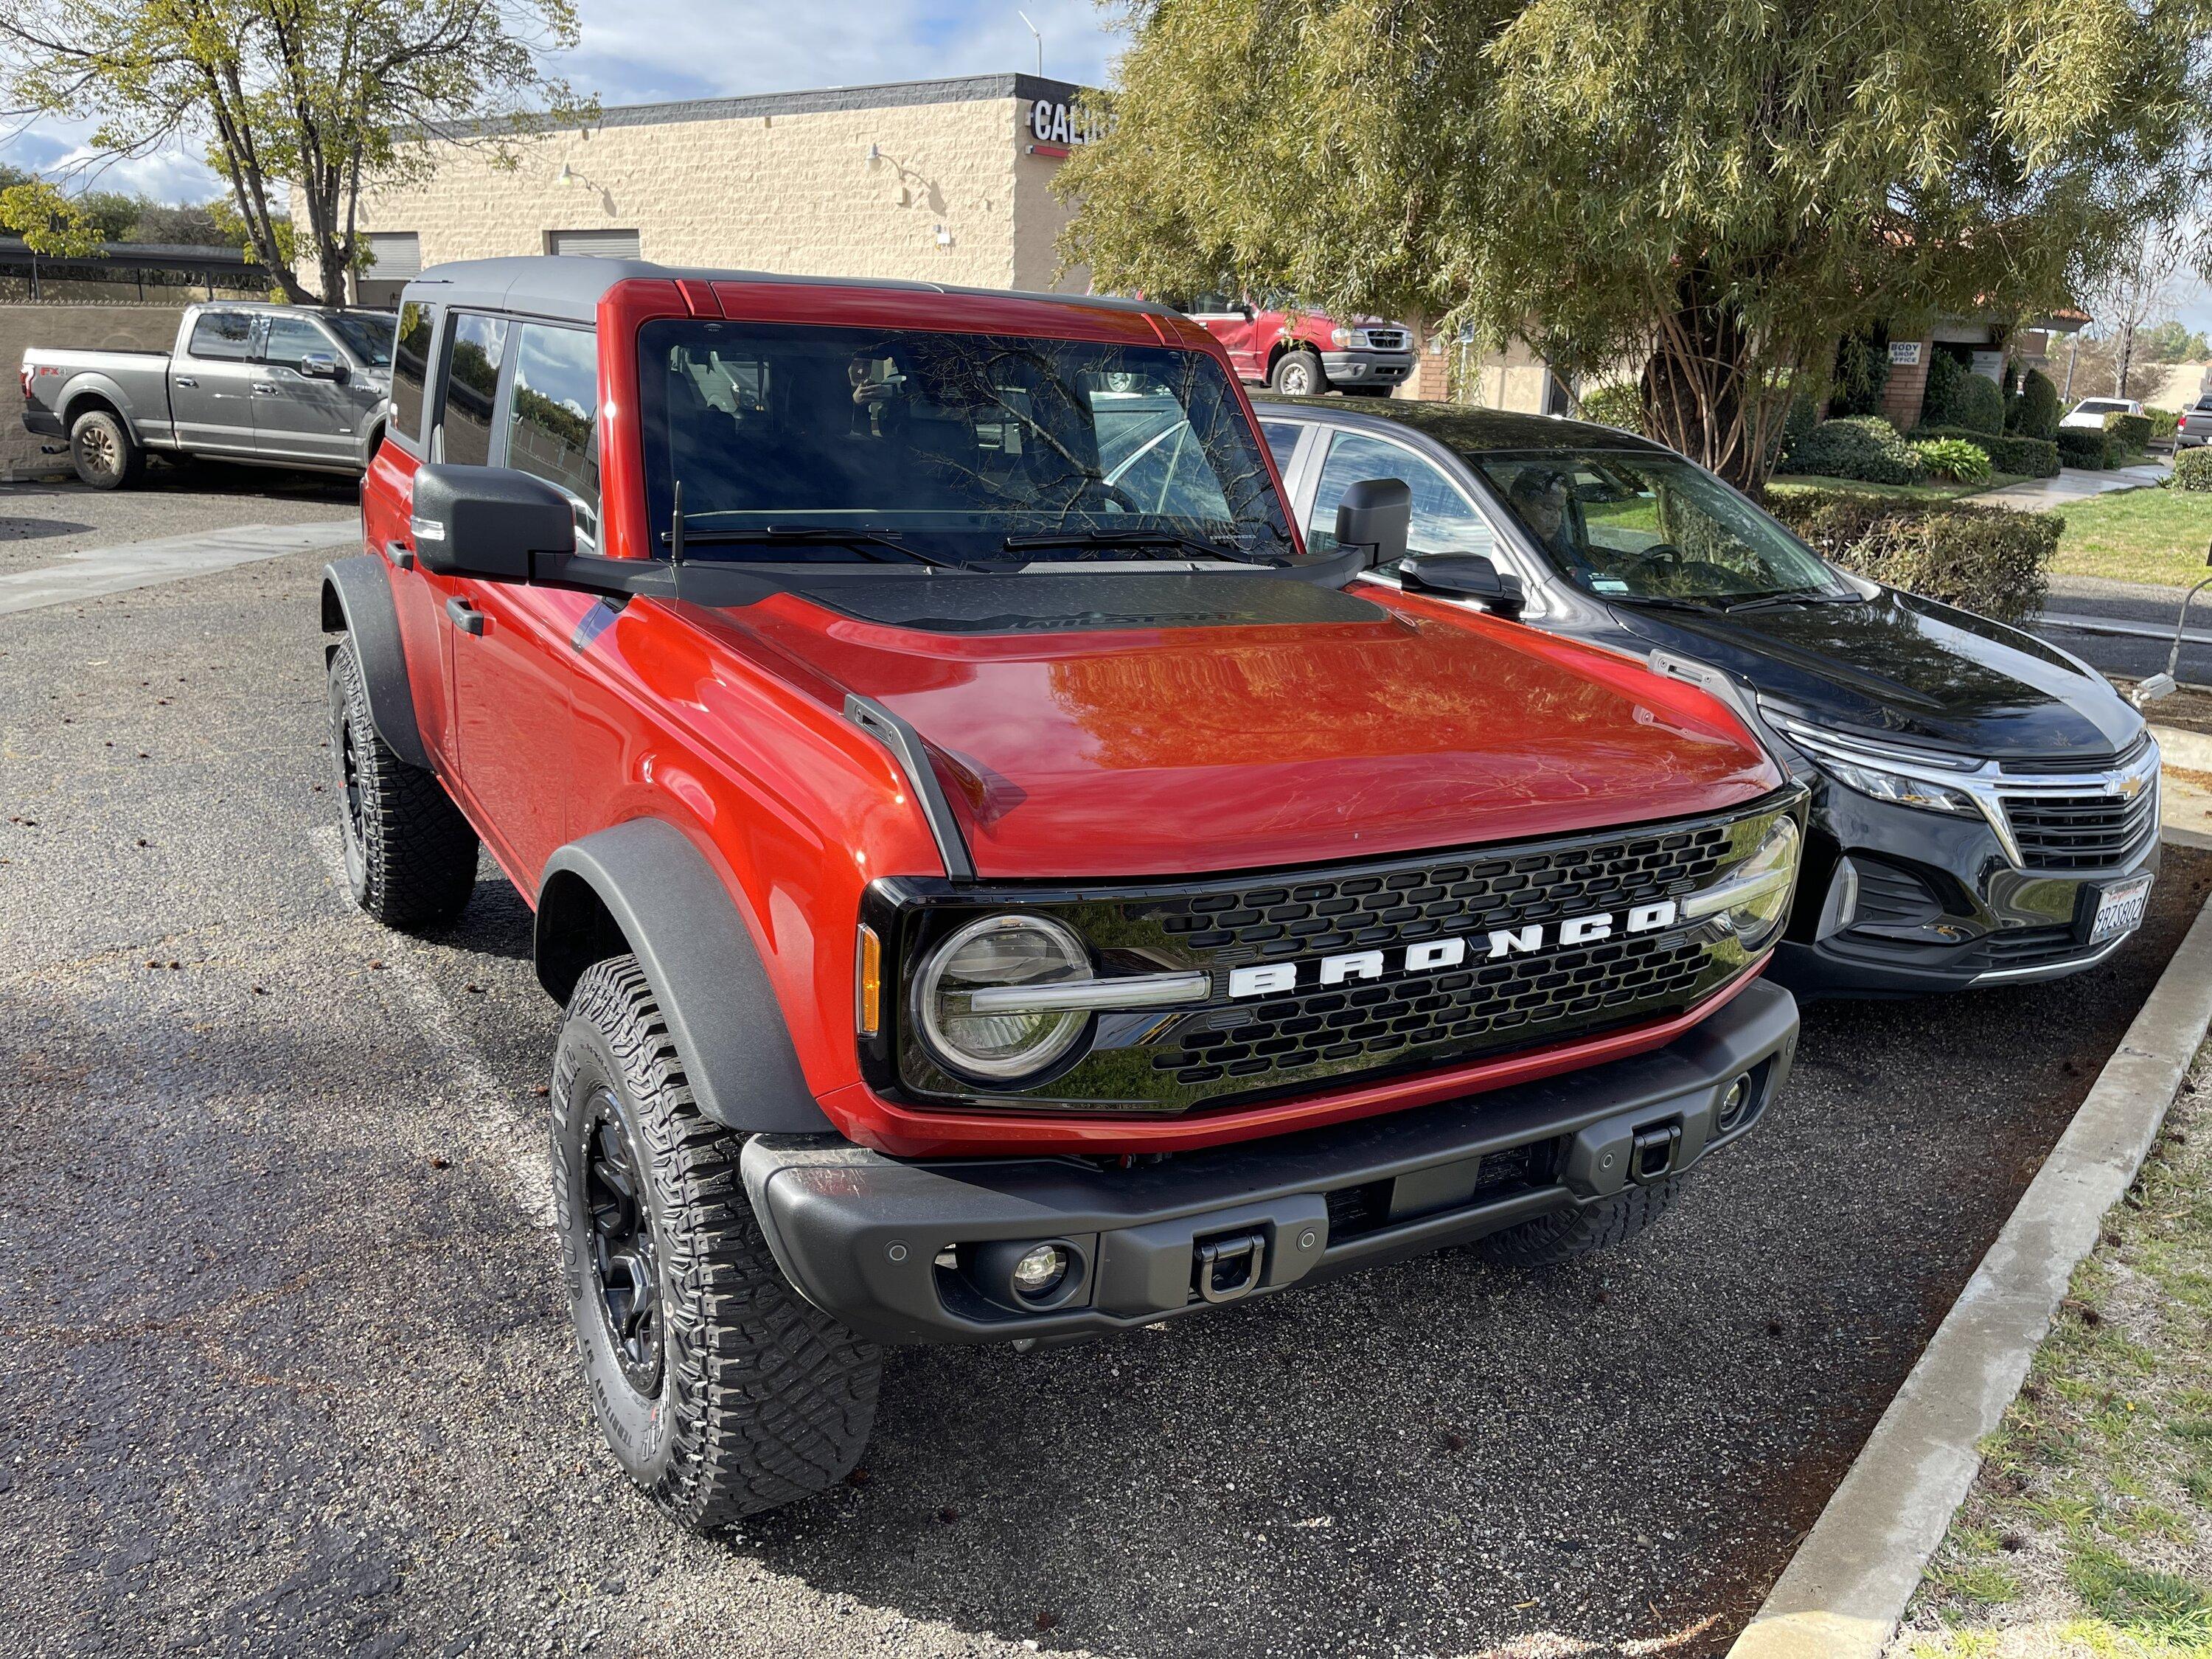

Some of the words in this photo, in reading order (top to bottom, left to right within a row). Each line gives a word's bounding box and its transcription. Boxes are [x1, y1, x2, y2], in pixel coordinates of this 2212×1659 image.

[40, 366, 68, 376] FX4
[2094, 897, 2142, 934] 9BZS802
[1228, 900, 1676, 998] BRONCO
[594, 1378, 632, 1447] TERRITORY
